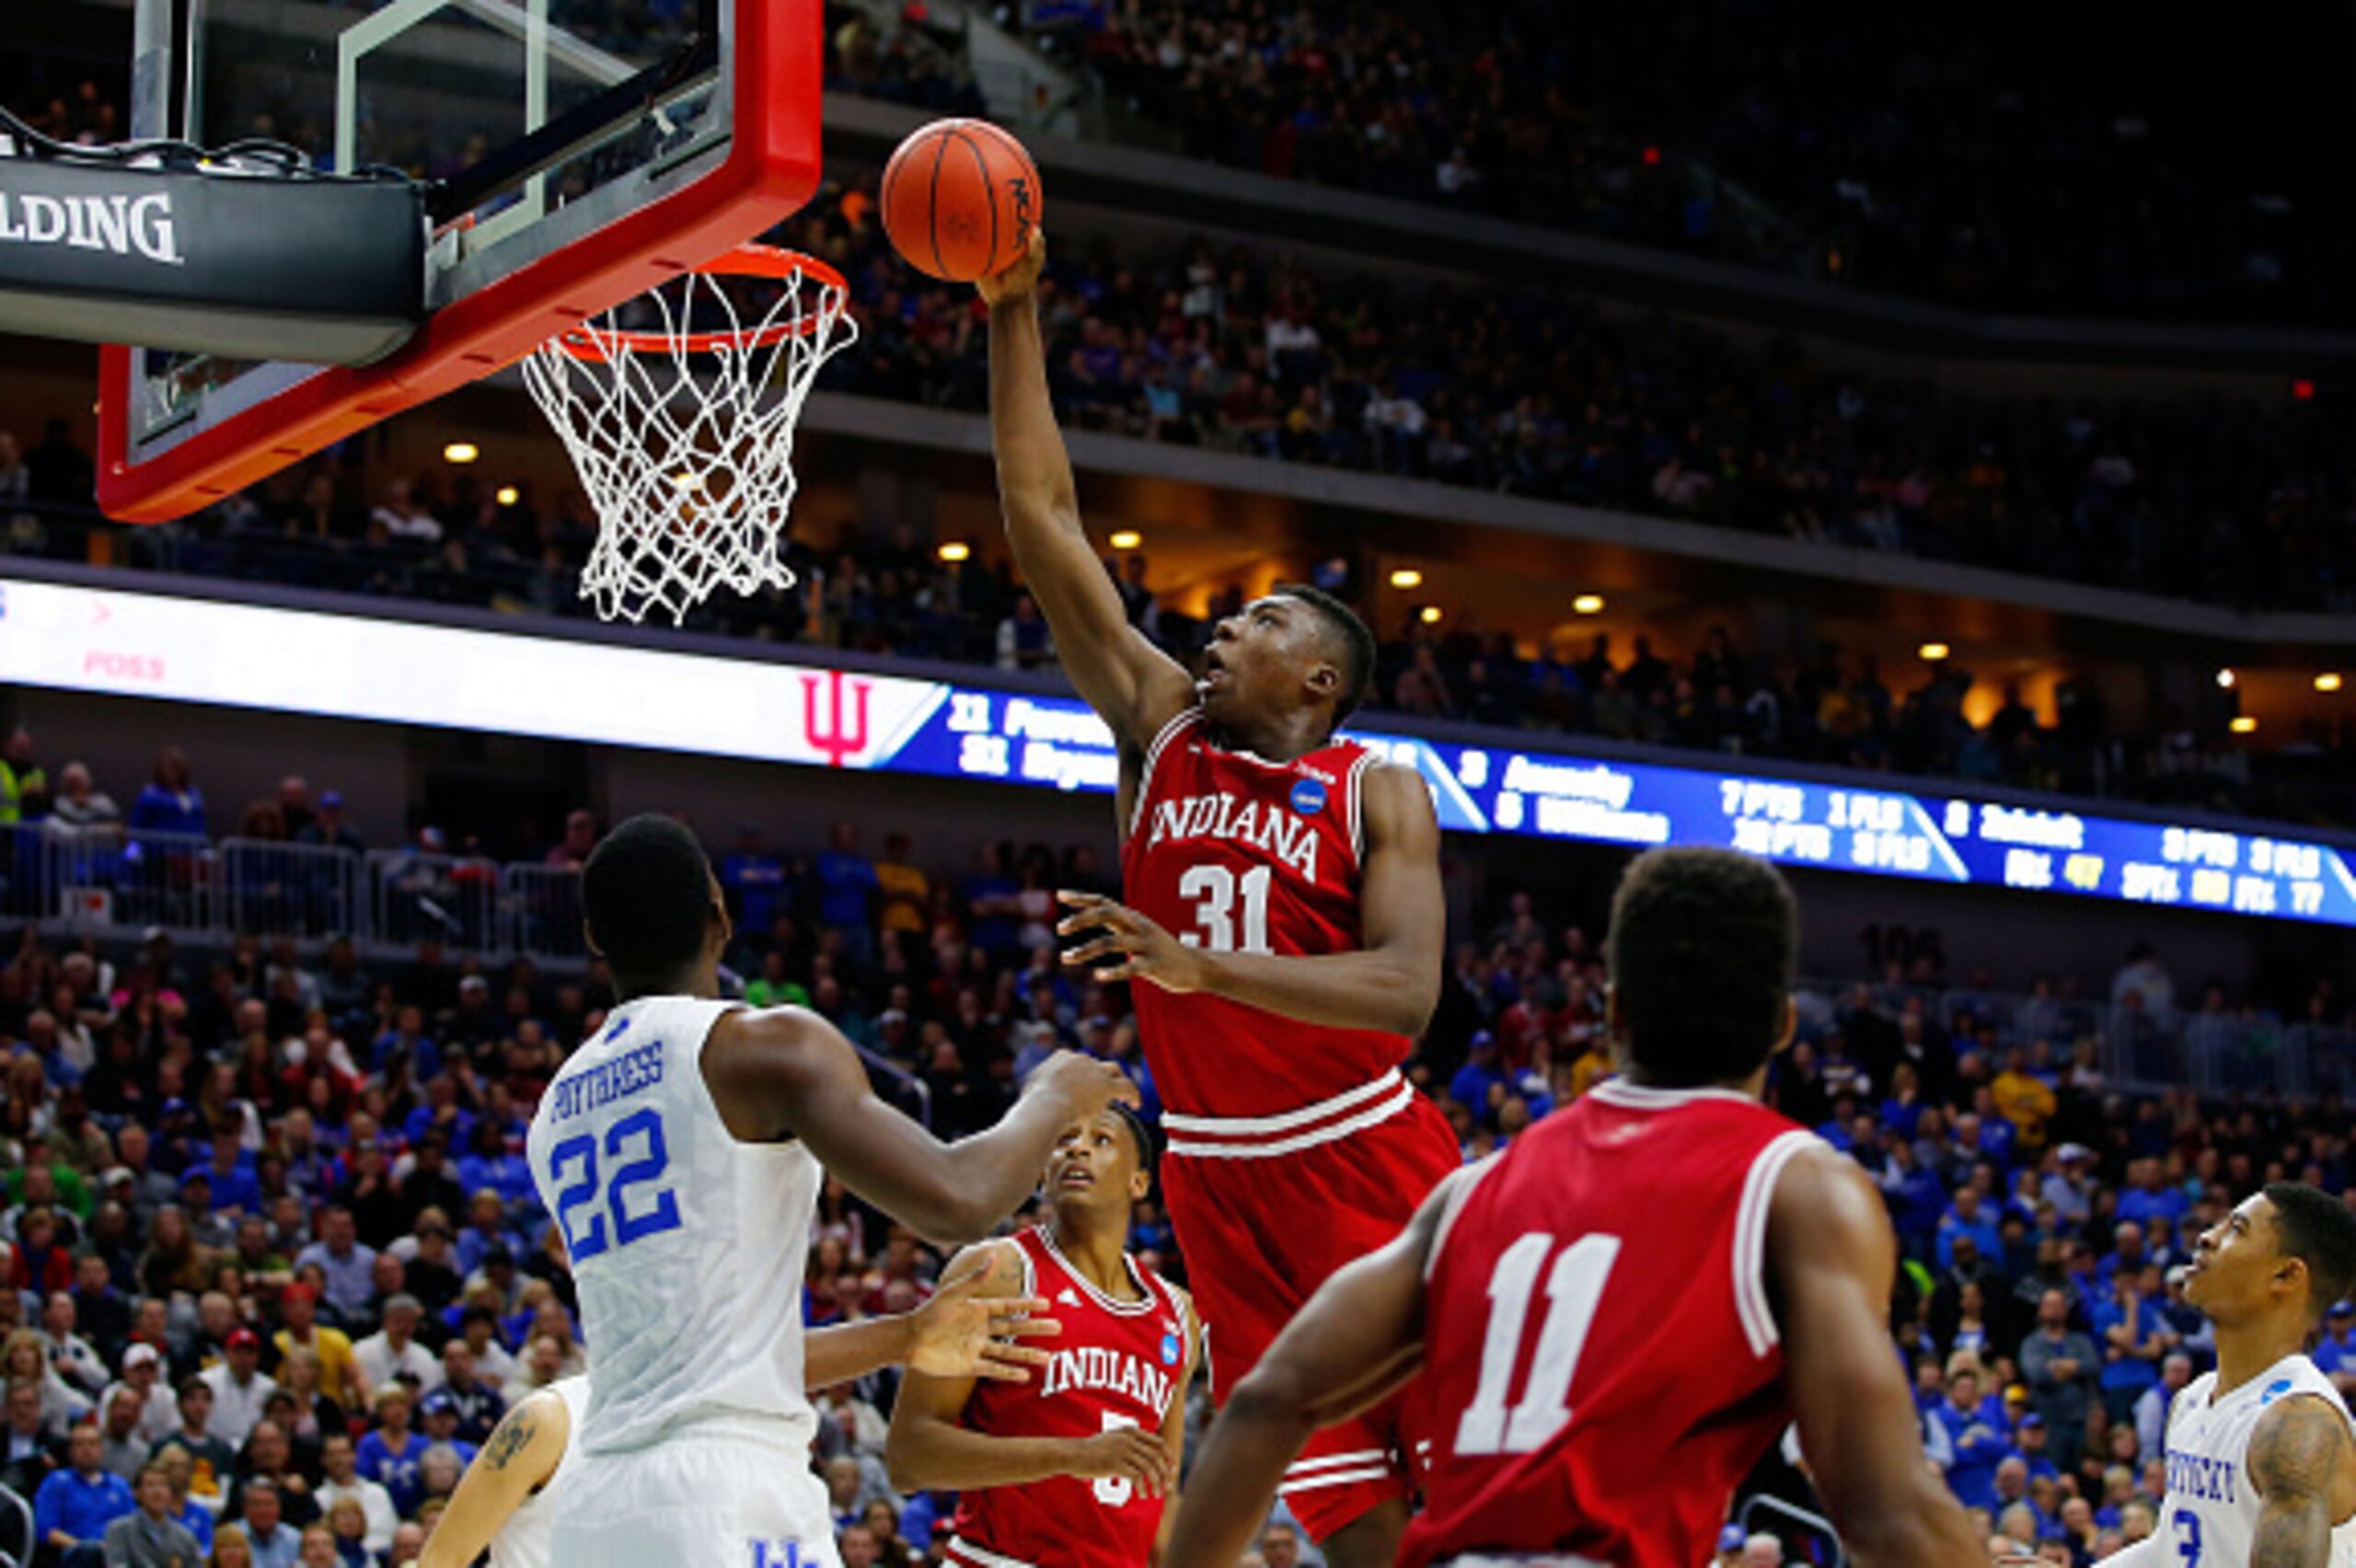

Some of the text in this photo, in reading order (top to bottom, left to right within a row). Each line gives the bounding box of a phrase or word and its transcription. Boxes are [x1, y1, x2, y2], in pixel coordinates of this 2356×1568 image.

[84, 650, 167, 682] POSS
[1148, 790, 1320, 885] INDIANA
[1179, 863, 1276, 955] 31
[549, 1106, 682, 1264] 22
[1452, 1231, 1622, 1456] 11
